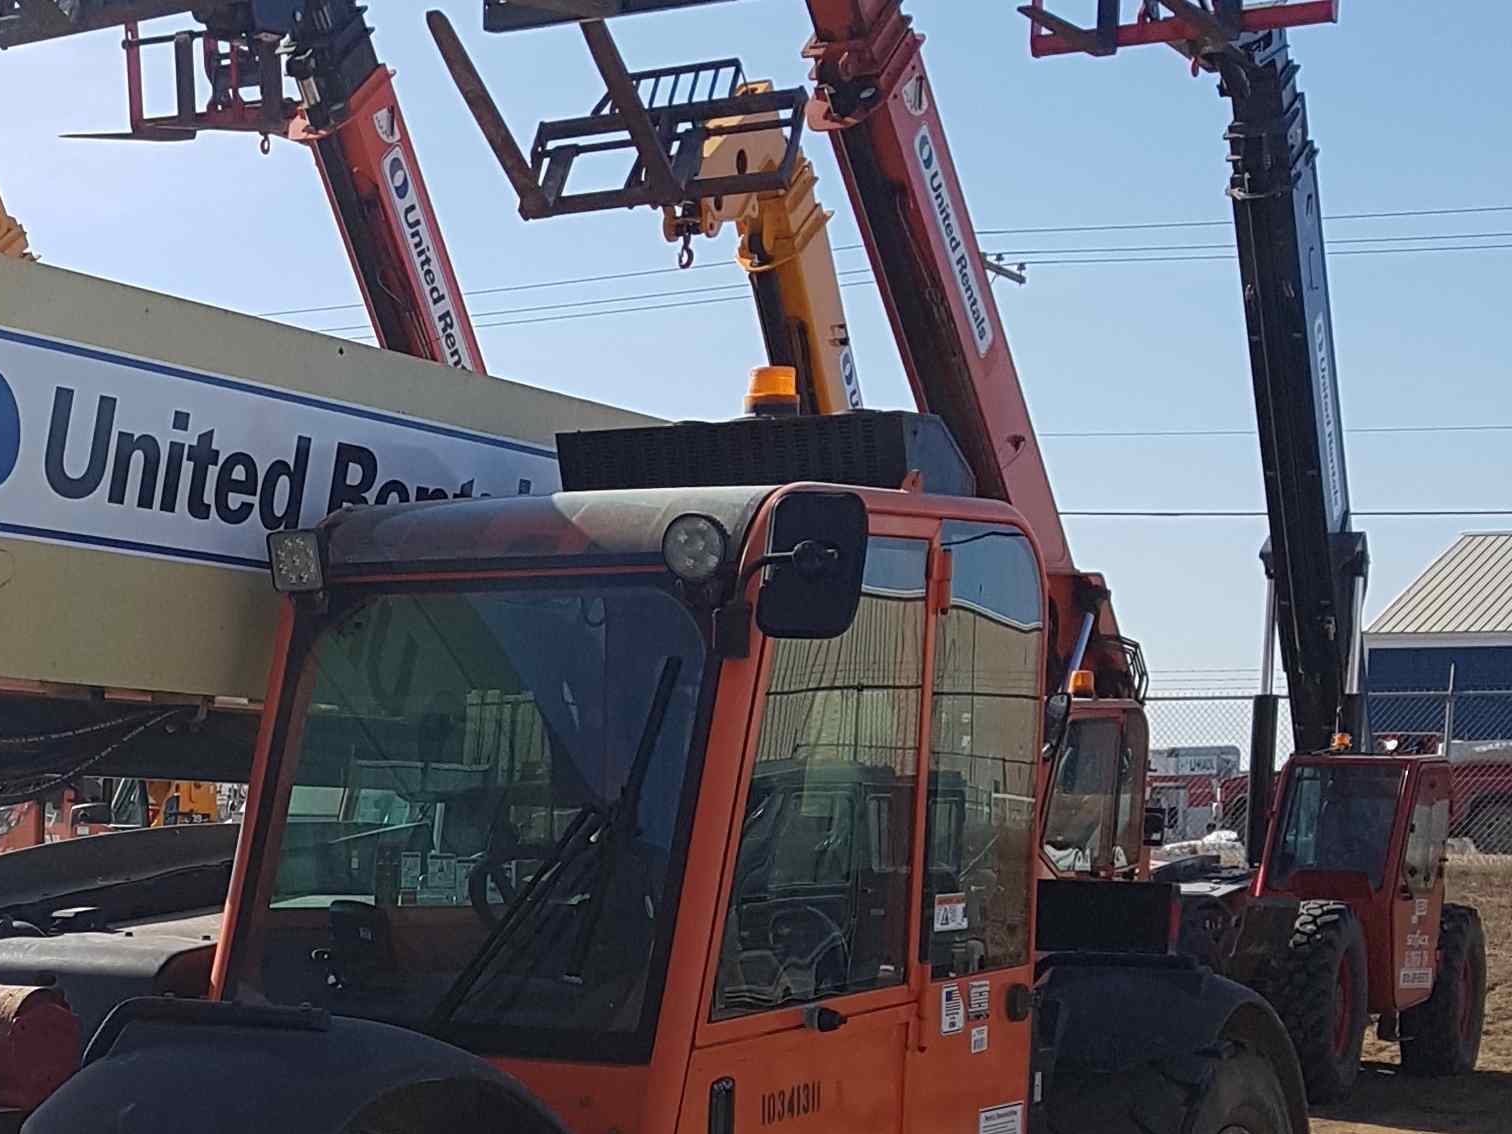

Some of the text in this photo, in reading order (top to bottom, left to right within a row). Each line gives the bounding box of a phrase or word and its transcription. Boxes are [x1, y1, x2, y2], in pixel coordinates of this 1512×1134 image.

[402, 203, 446, 305] United
[929, 169, 987, 341] United Rentals
[44, 386, 312, 531] United
